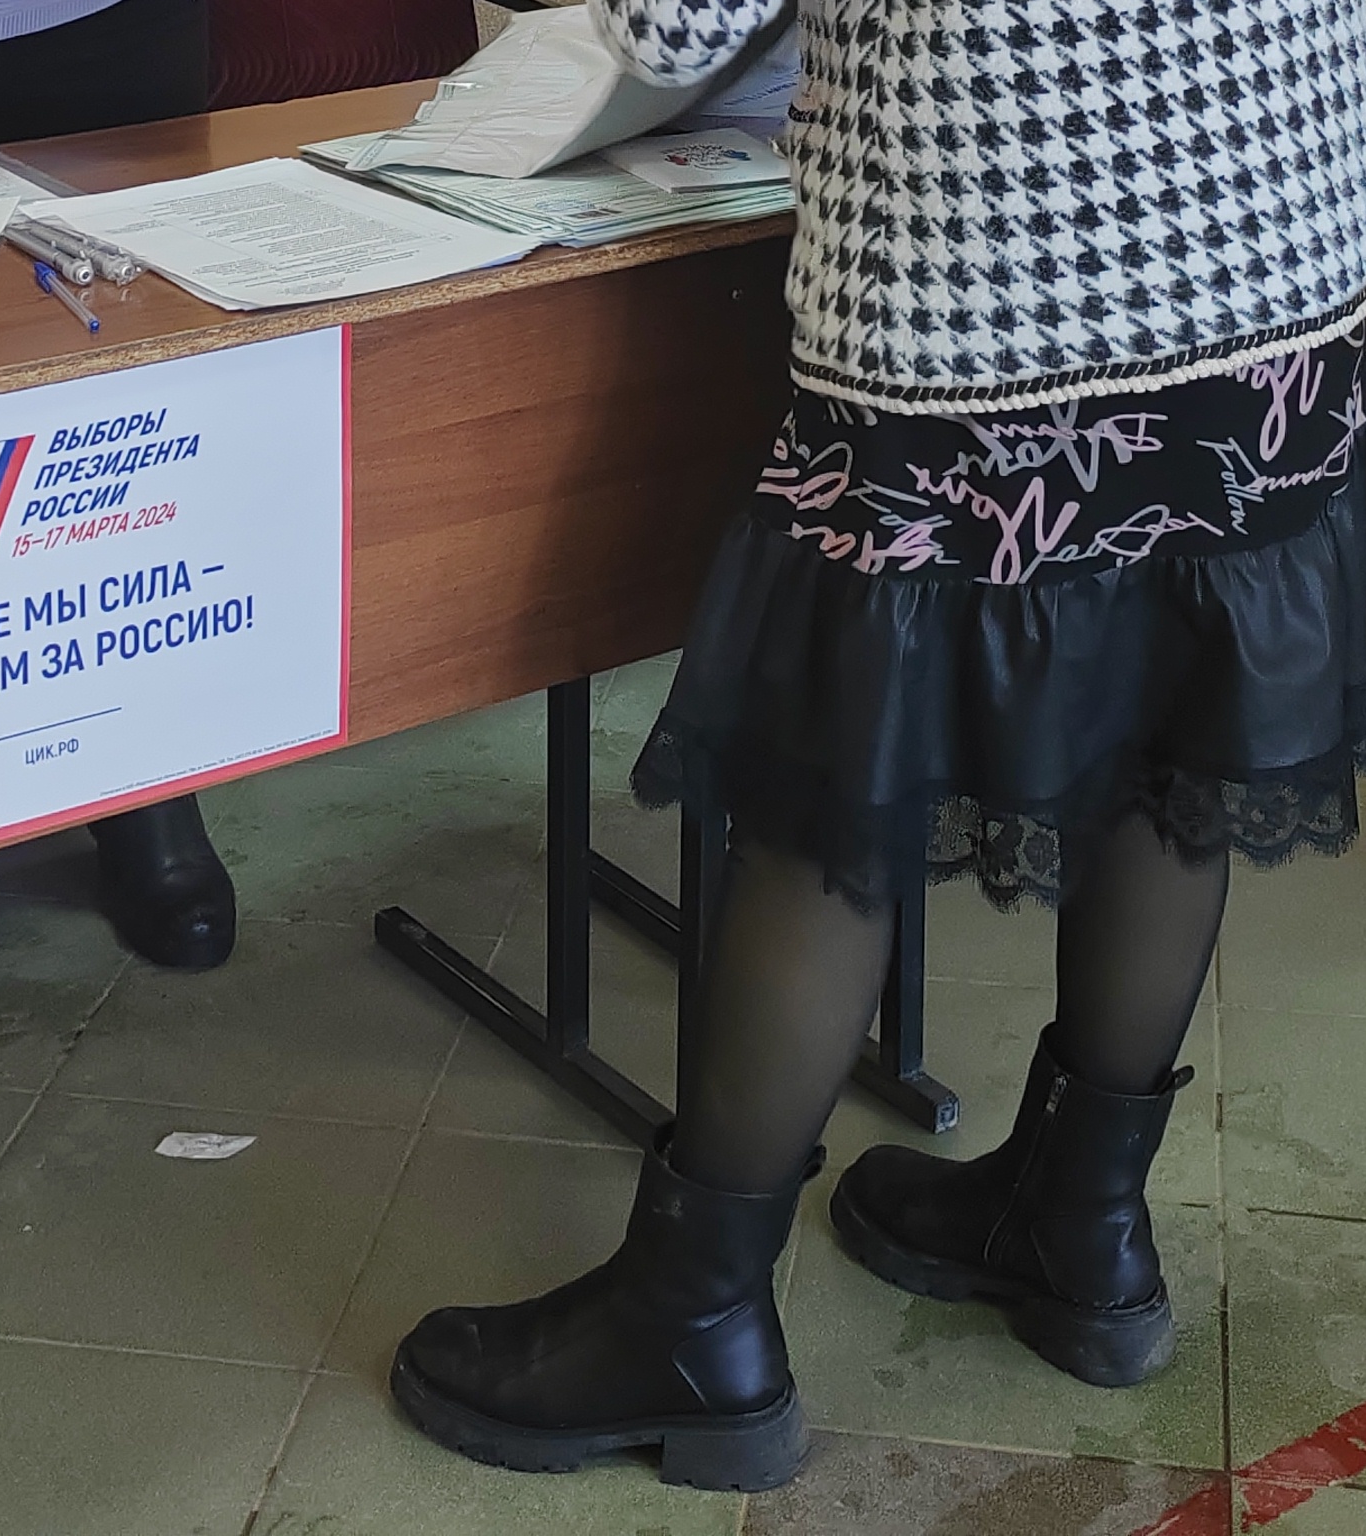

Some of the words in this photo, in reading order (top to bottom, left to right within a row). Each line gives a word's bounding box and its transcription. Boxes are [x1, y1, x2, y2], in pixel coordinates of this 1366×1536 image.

[46, 407, 168, 455] ВЫБОРЫ
[32, 433, 202, 491] ПРЕЗИДЕНТА
[20, 480, 130, 527] РОССИИ
[65, 510, 129, 546] МАРТА
[131, 500, 178, 532] 2024
[23, 583, 88, 633] МЫ
[98, 560, 192, 613] СИЛА
[40, 637, 85, 680] ЗА
[96, 594, 255, 667] РОССИЮ!
[23, 736, 81, 767] ЦИК.РФ
